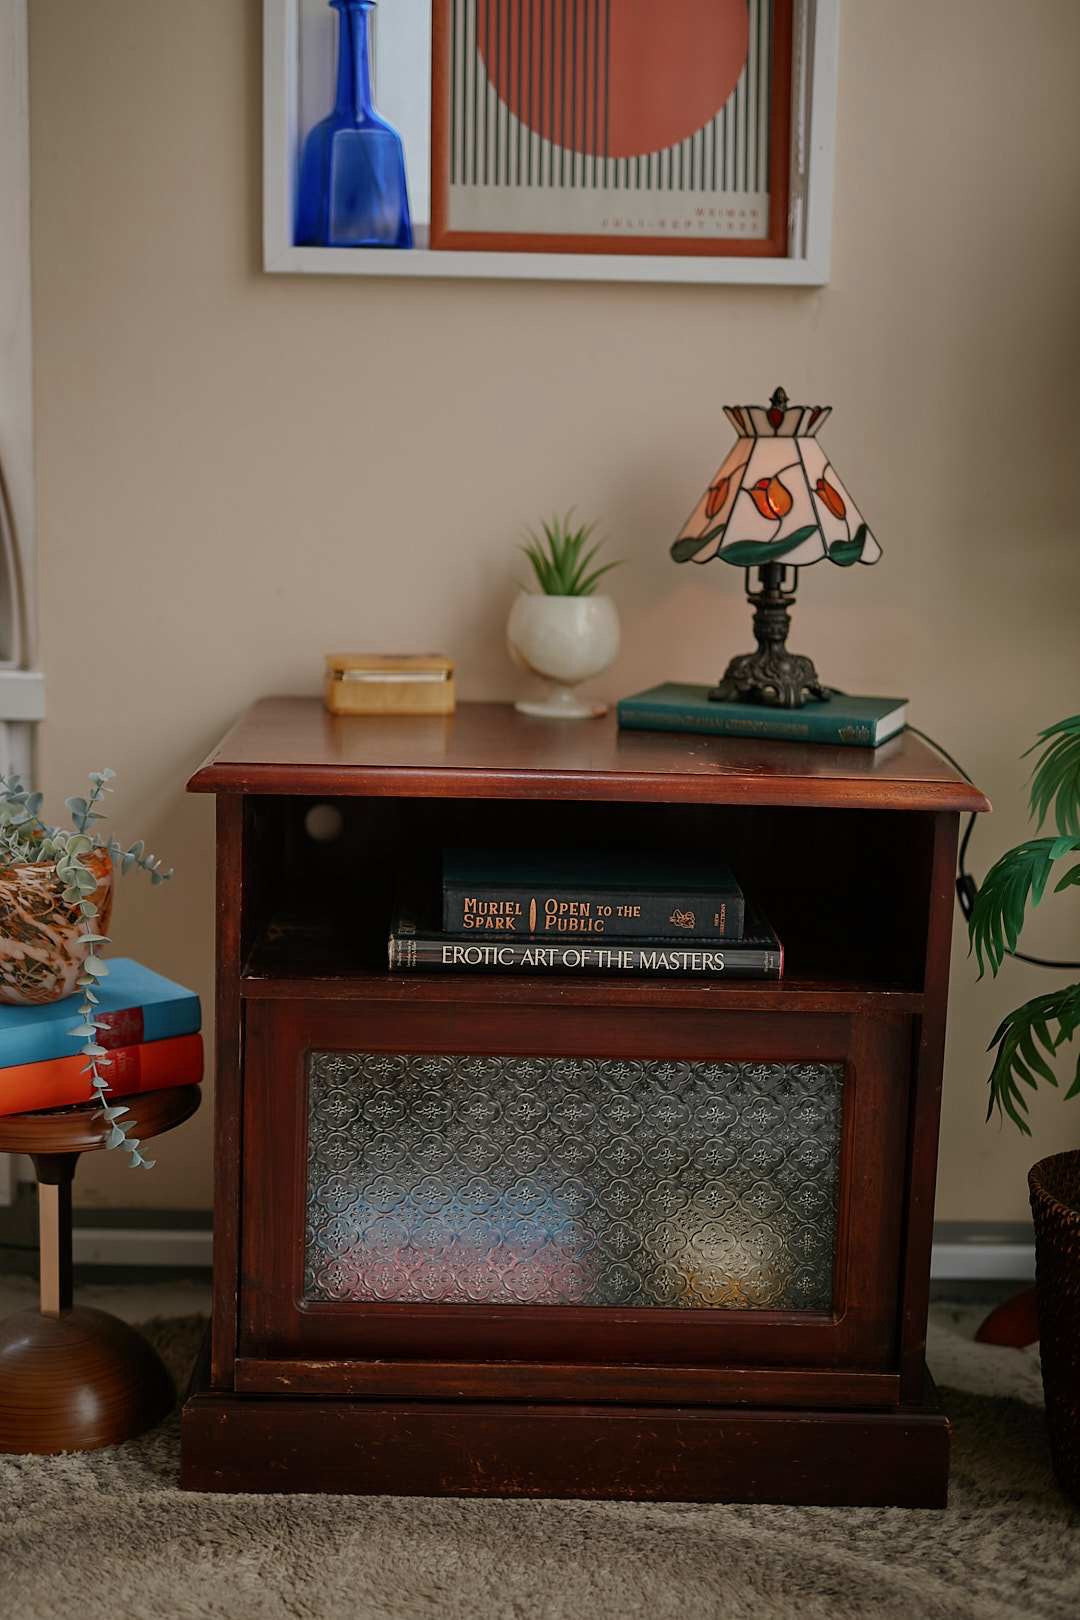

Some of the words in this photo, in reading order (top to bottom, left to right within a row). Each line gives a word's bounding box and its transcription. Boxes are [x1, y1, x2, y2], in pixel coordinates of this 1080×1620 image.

[463, 898, 522, 916] MURIEL
[544, 899, 591, 917] OPEN
[596, 905, 612, 917] TO
[616, 906, 641, 918] THE
[463, 914, 517, 931] SPARK
[544, 915, 605, 933] PUBLIC
[442, 946, 515, 966] EROTIC
[520, 948, 559, 967] ART
[562, 949, 591, 968] OF
[594, 950, 634, 969] THE
[639, 952, 725, 971] MASTERS
